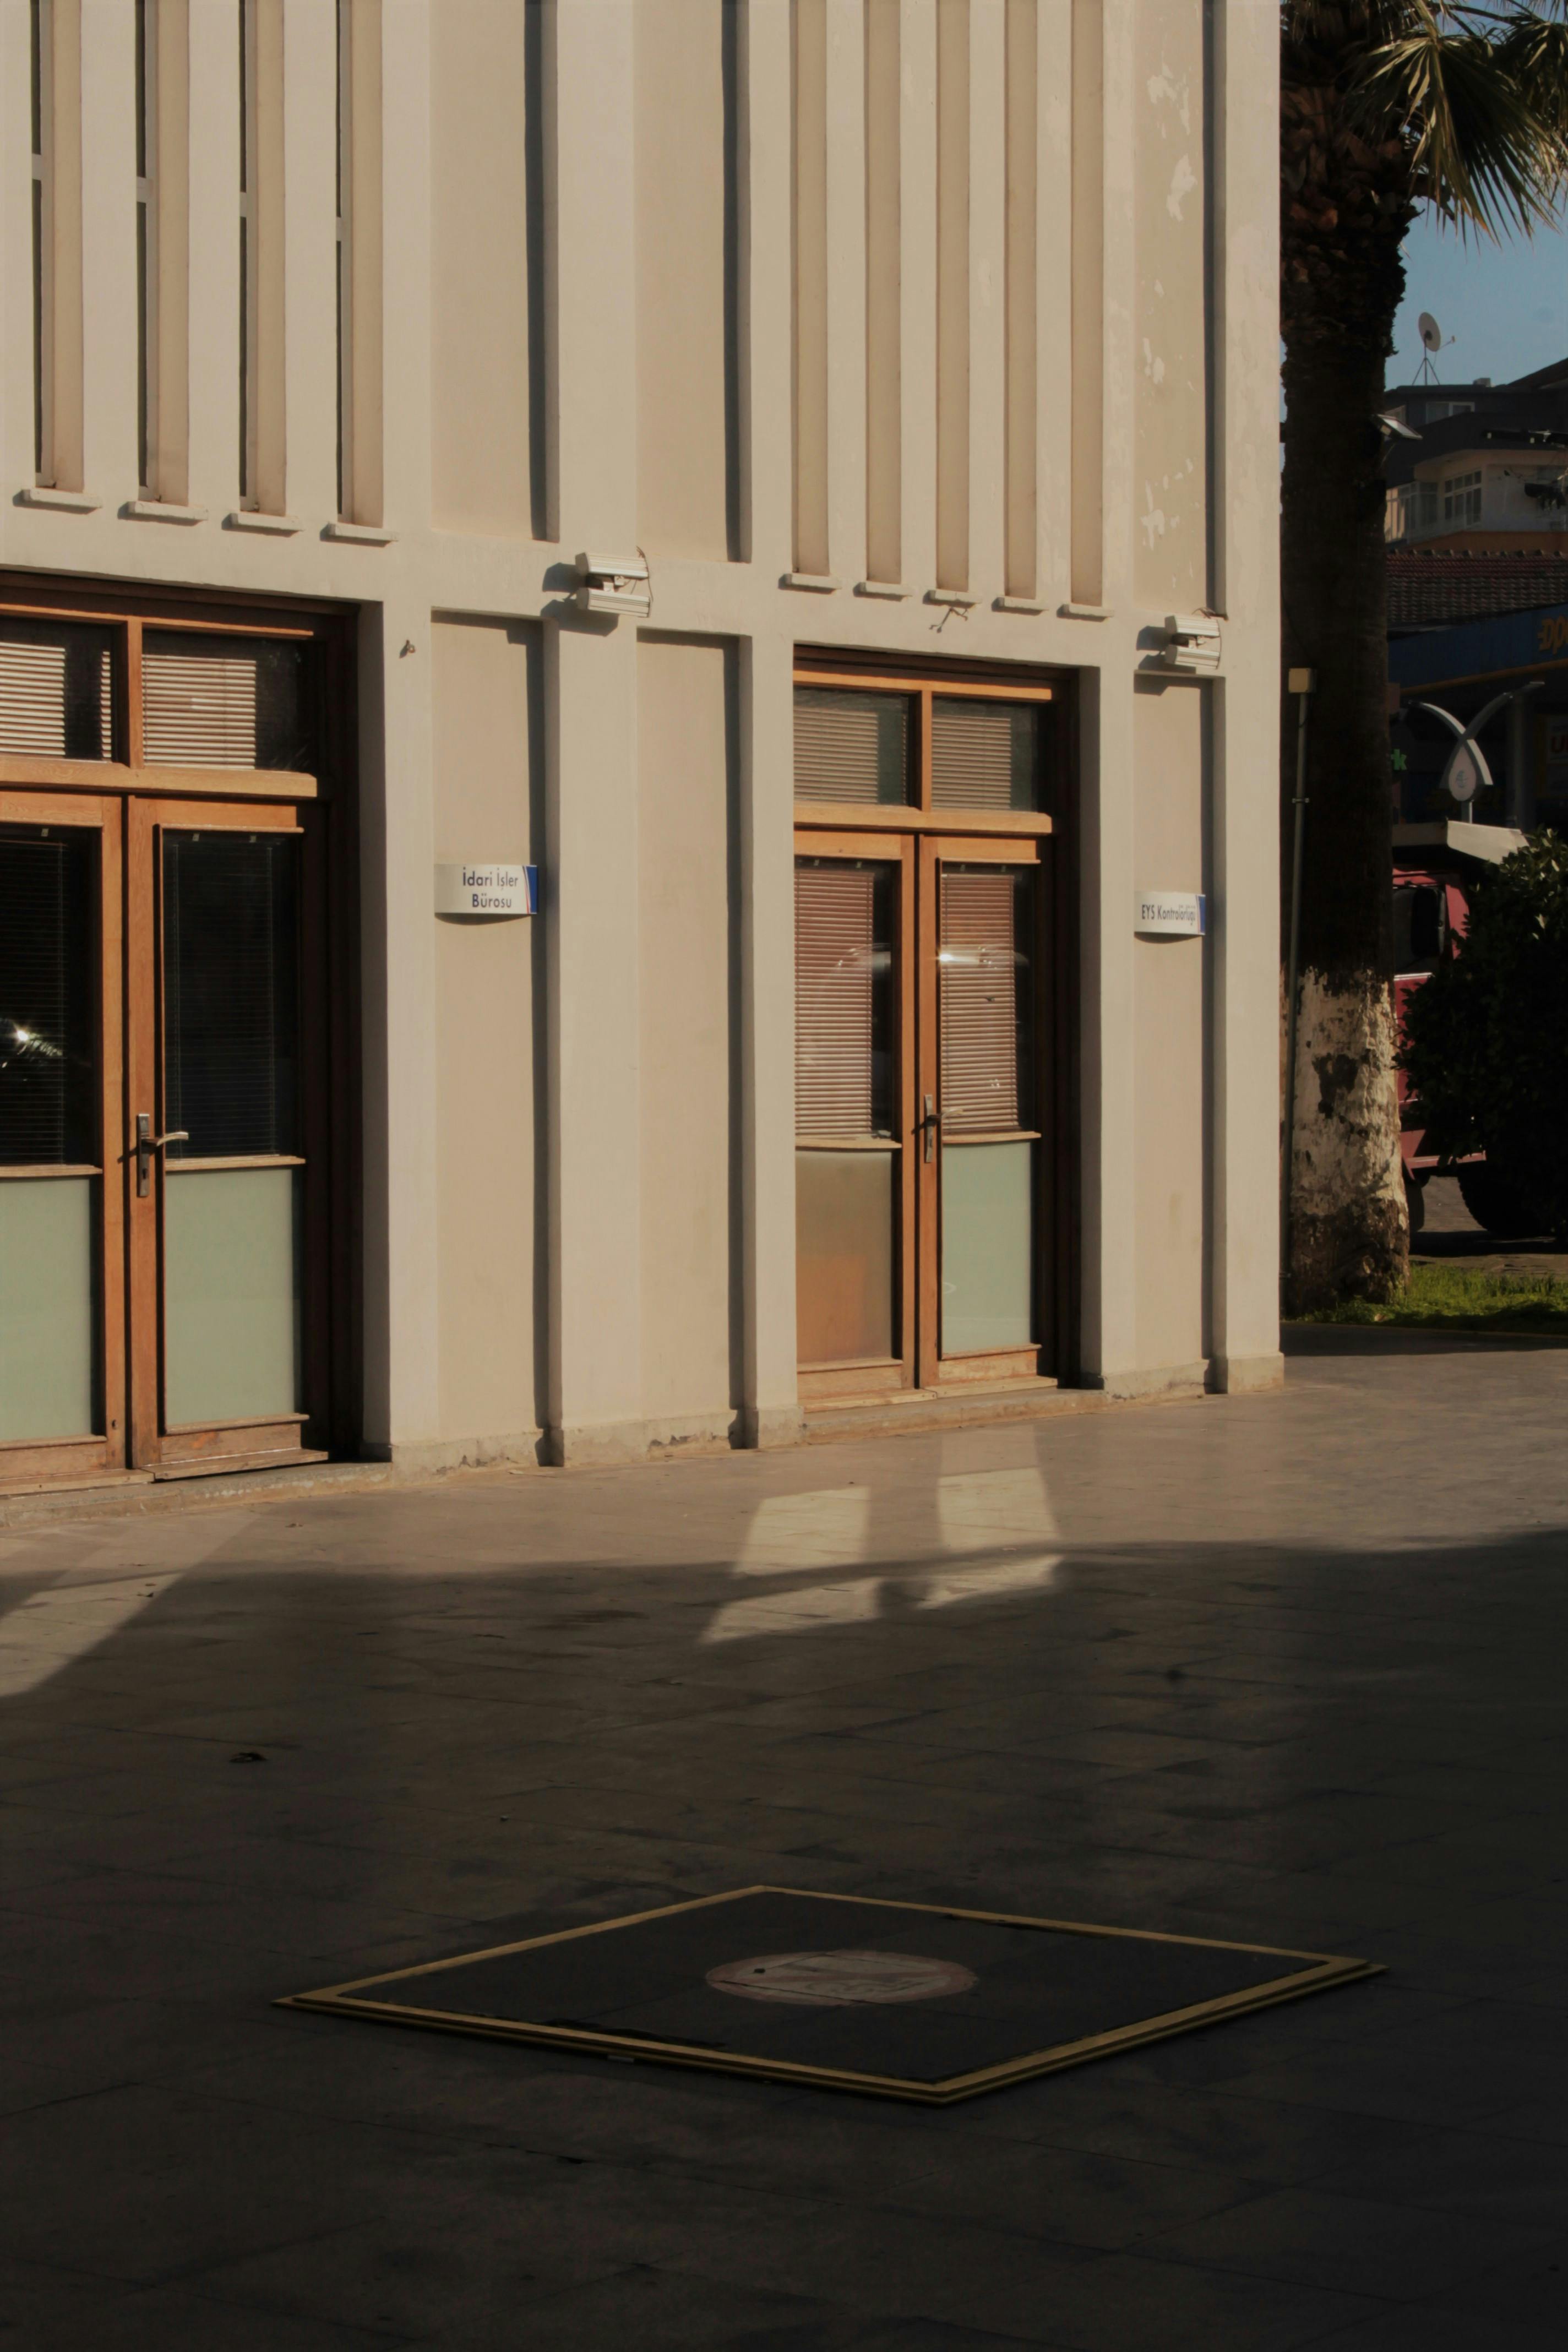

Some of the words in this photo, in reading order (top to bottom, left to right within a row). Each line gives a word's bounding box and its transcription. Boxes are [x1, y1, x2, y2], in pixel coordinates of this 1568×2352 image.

[462, 866, 492, 886] İdari
[472, 893, 511, 908] Bürosu
[1141, 904, 1155, 920] EYS
